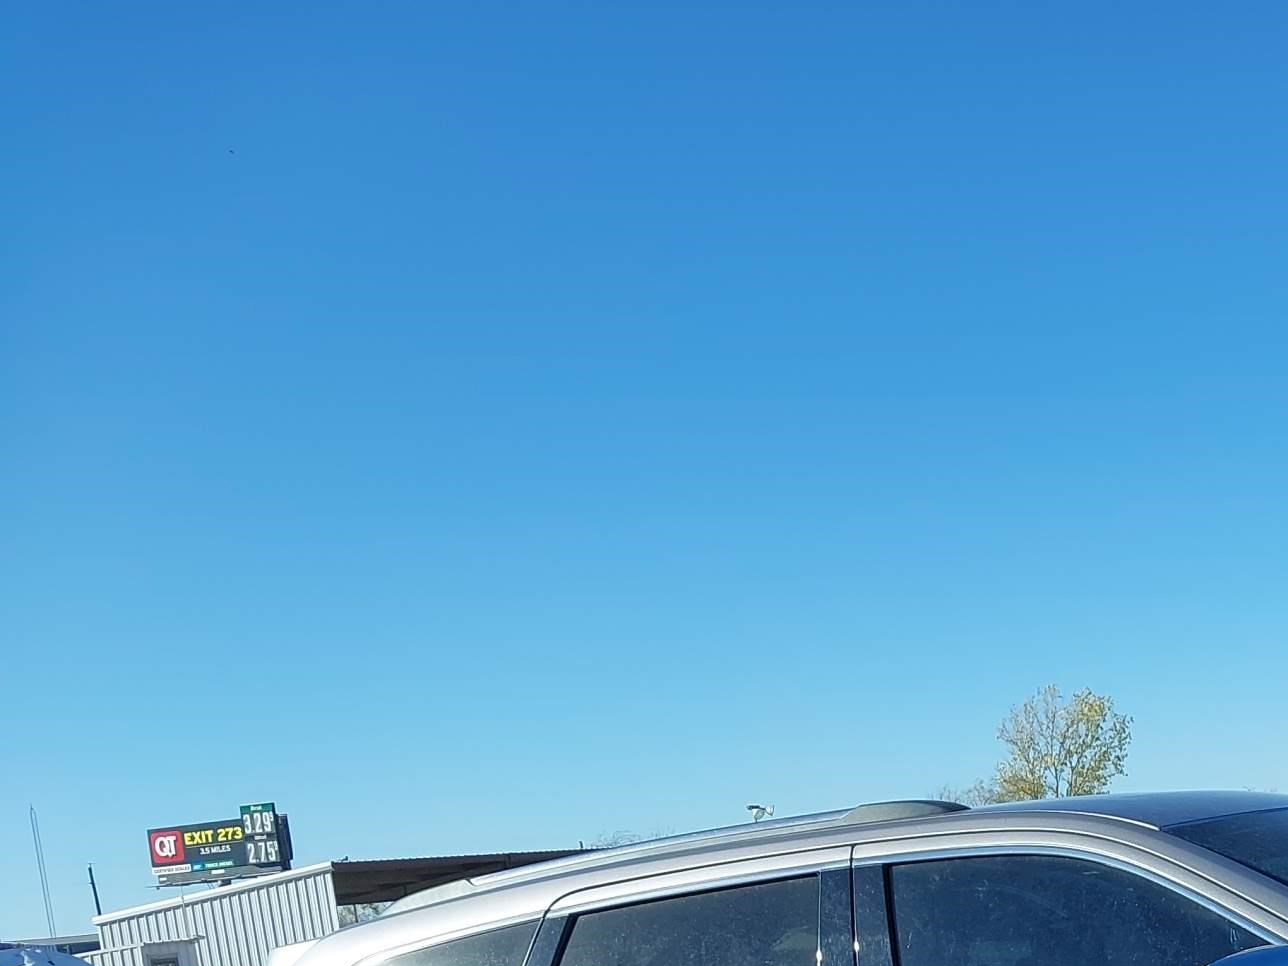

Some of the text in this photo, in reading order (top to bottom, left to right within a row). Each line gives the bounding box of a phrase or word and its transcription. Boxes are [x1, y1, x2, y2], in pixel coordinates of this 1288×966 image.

[184, 826, 243, 846] EXIT 273
[154, 835, 177, 858] QT
[211, 844, 231, 854] MILES
